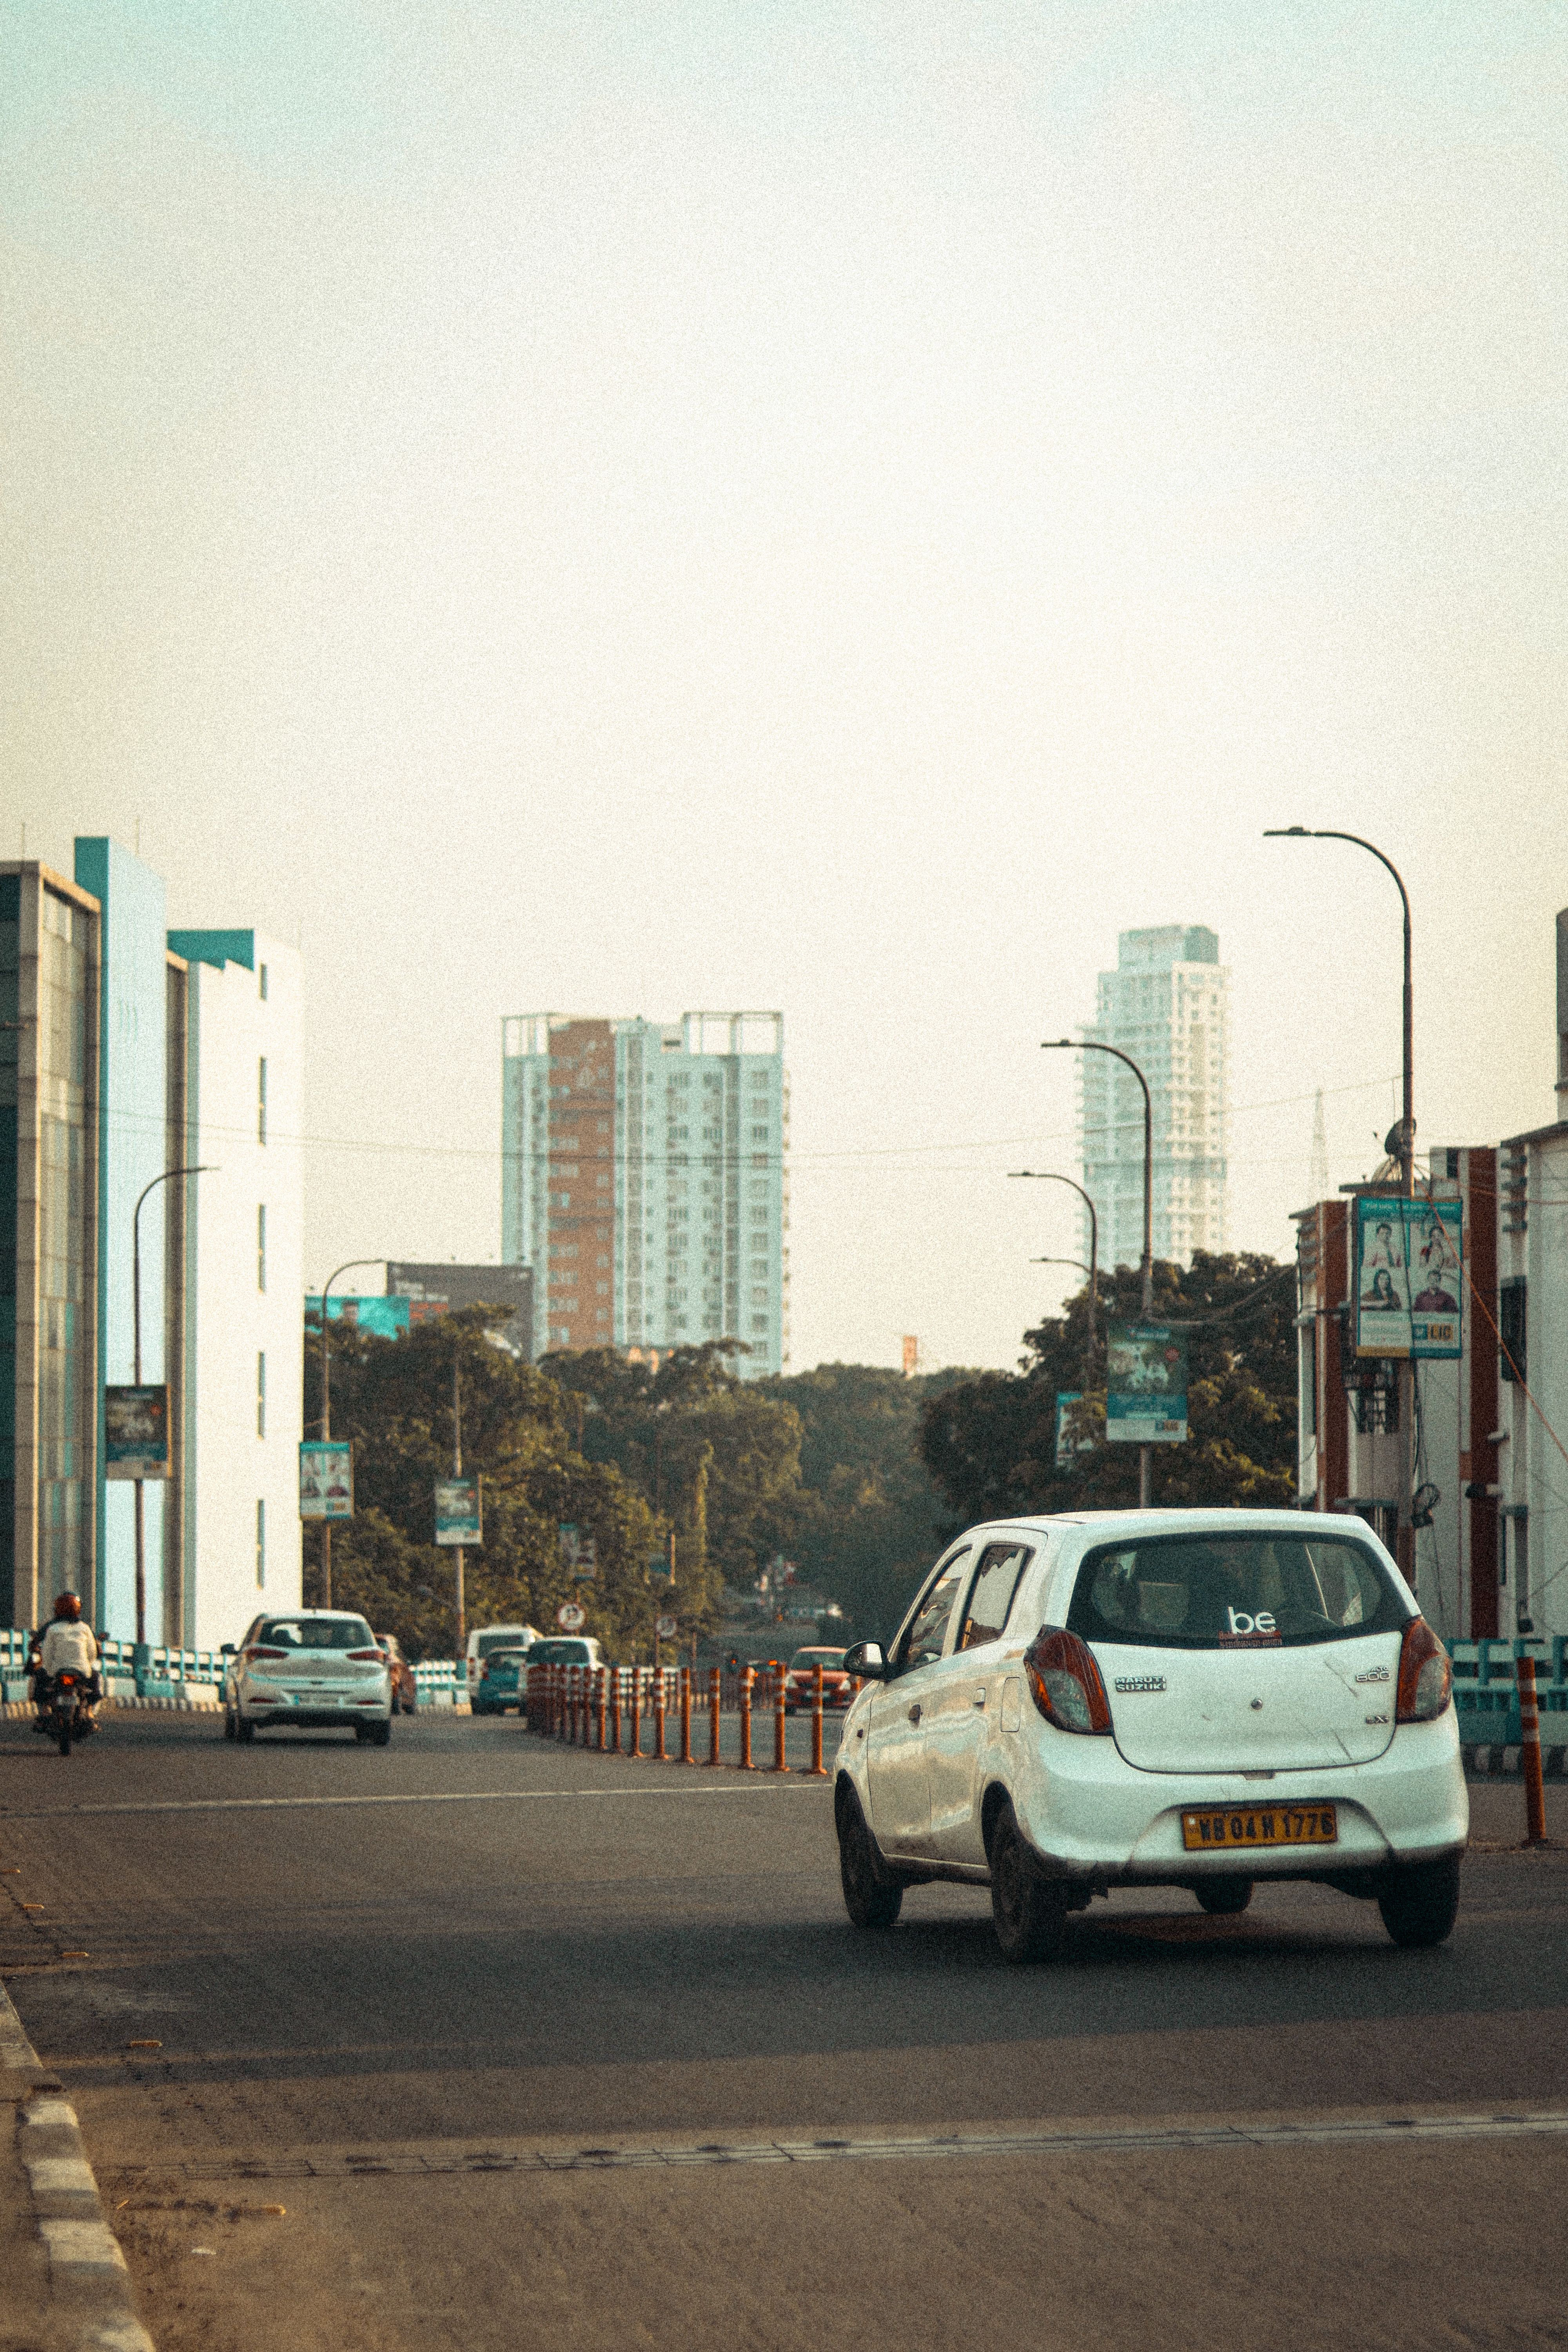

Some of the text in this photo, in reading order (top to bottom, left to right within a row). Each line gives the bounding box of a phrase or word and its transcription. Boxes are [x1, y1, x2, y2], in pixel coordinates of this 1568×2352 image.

[1430, 1325, 1451, 1339] LIC
[1228, 1606, 1277, 1634] be
[1356, 1671, 1390, 1682] 800
[1116, 1683, 1167, 1691] SUZUKI
